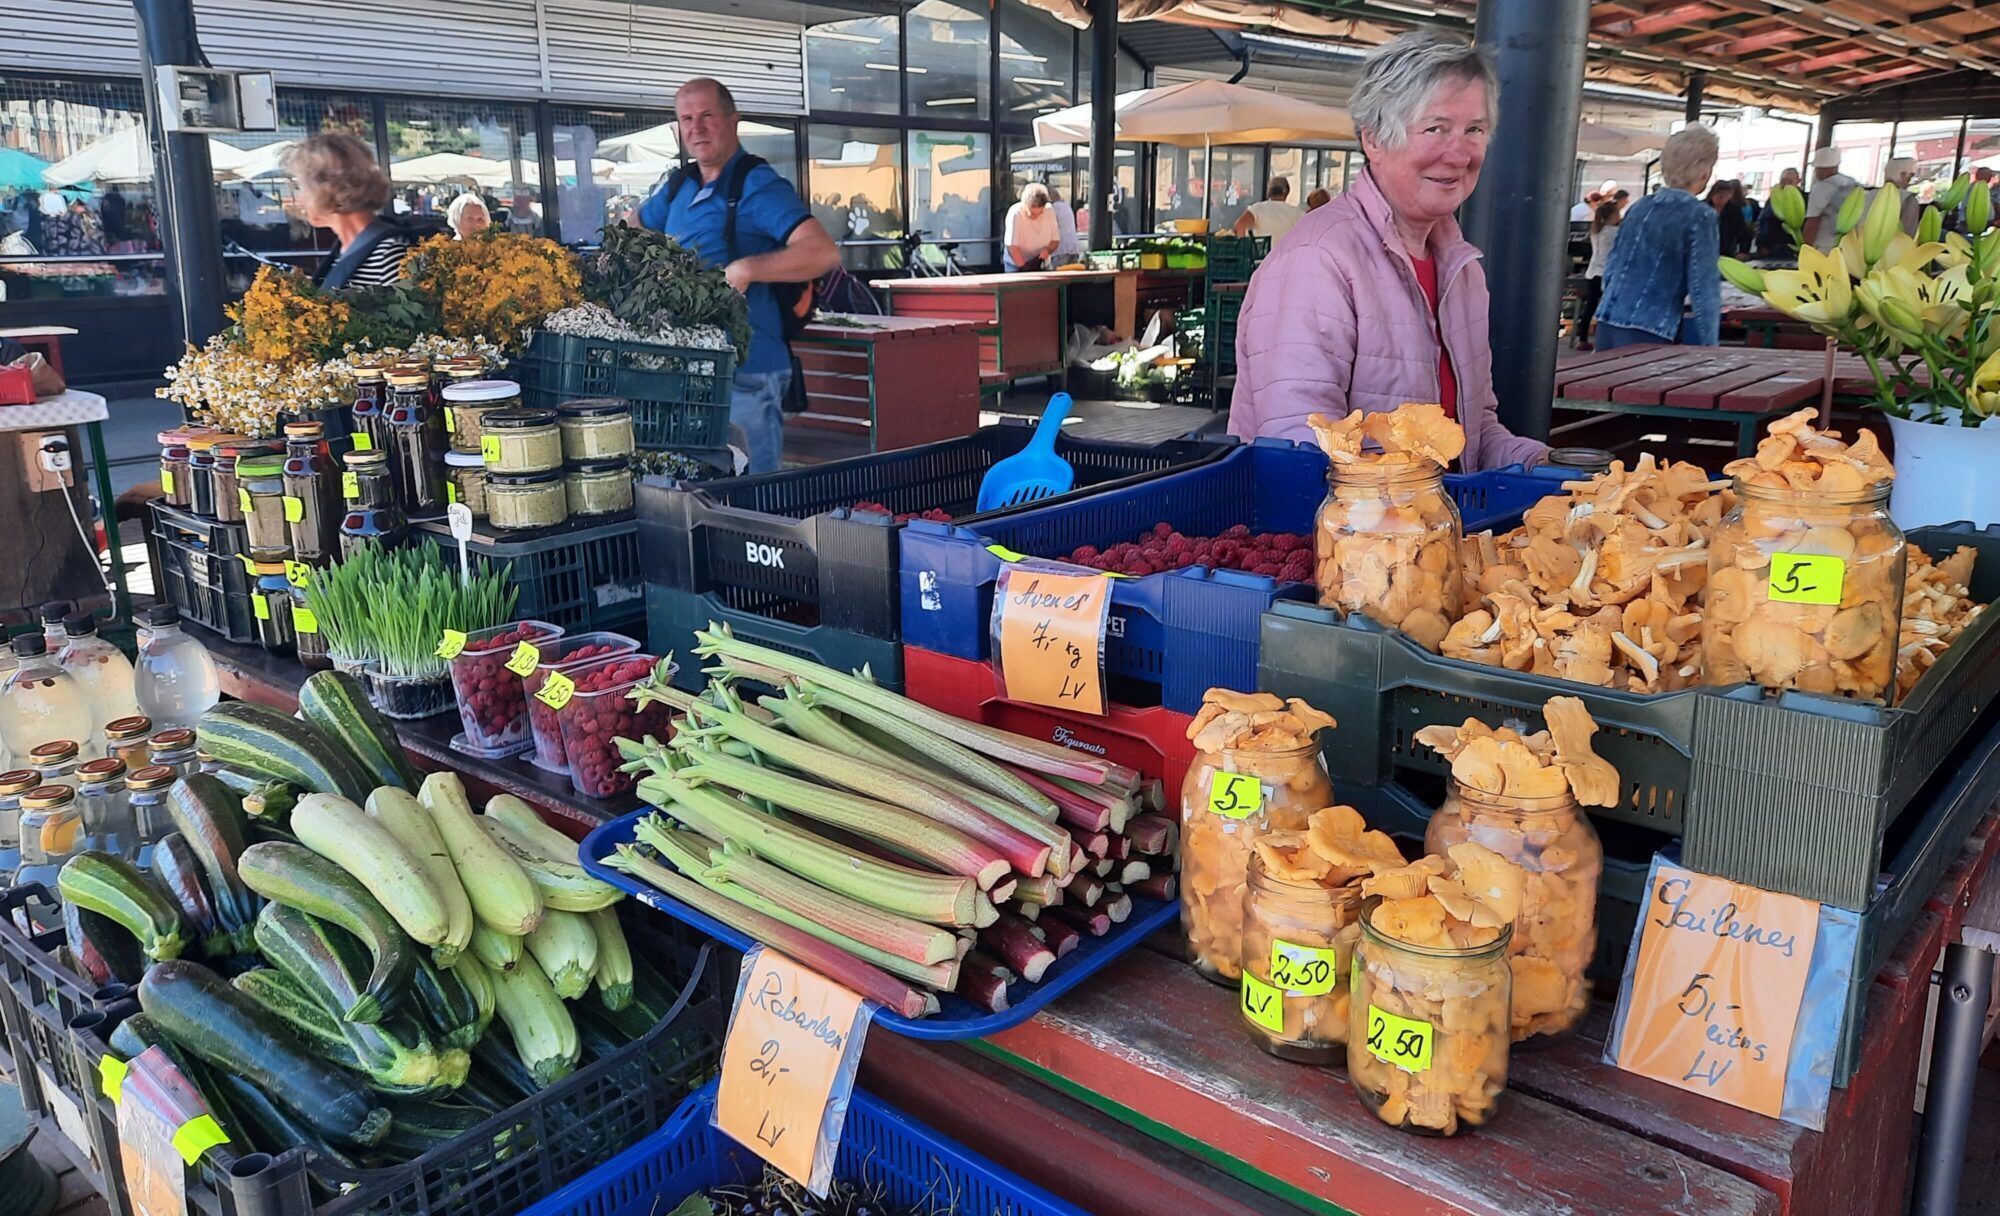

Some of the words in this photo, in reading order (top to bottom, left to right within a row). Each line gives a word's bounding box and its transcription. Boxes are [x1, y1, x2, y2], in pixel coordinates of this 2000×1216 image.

[745, 541, 785, 569] BOK
[1014, 579, 1090, 611] Avenes
[1065, 641, 1082, 669] kg
[1058, 675, 1086, 700] LV
[1655, 878, 1796, 957] Gailenes
[1273, 954, 1330, 986] 2.50
[1367, 1016, 1424, 1059] 2.50
[1682, 1050, 1732, 1087] LV
[756, 1109, 786, 1148] LV
